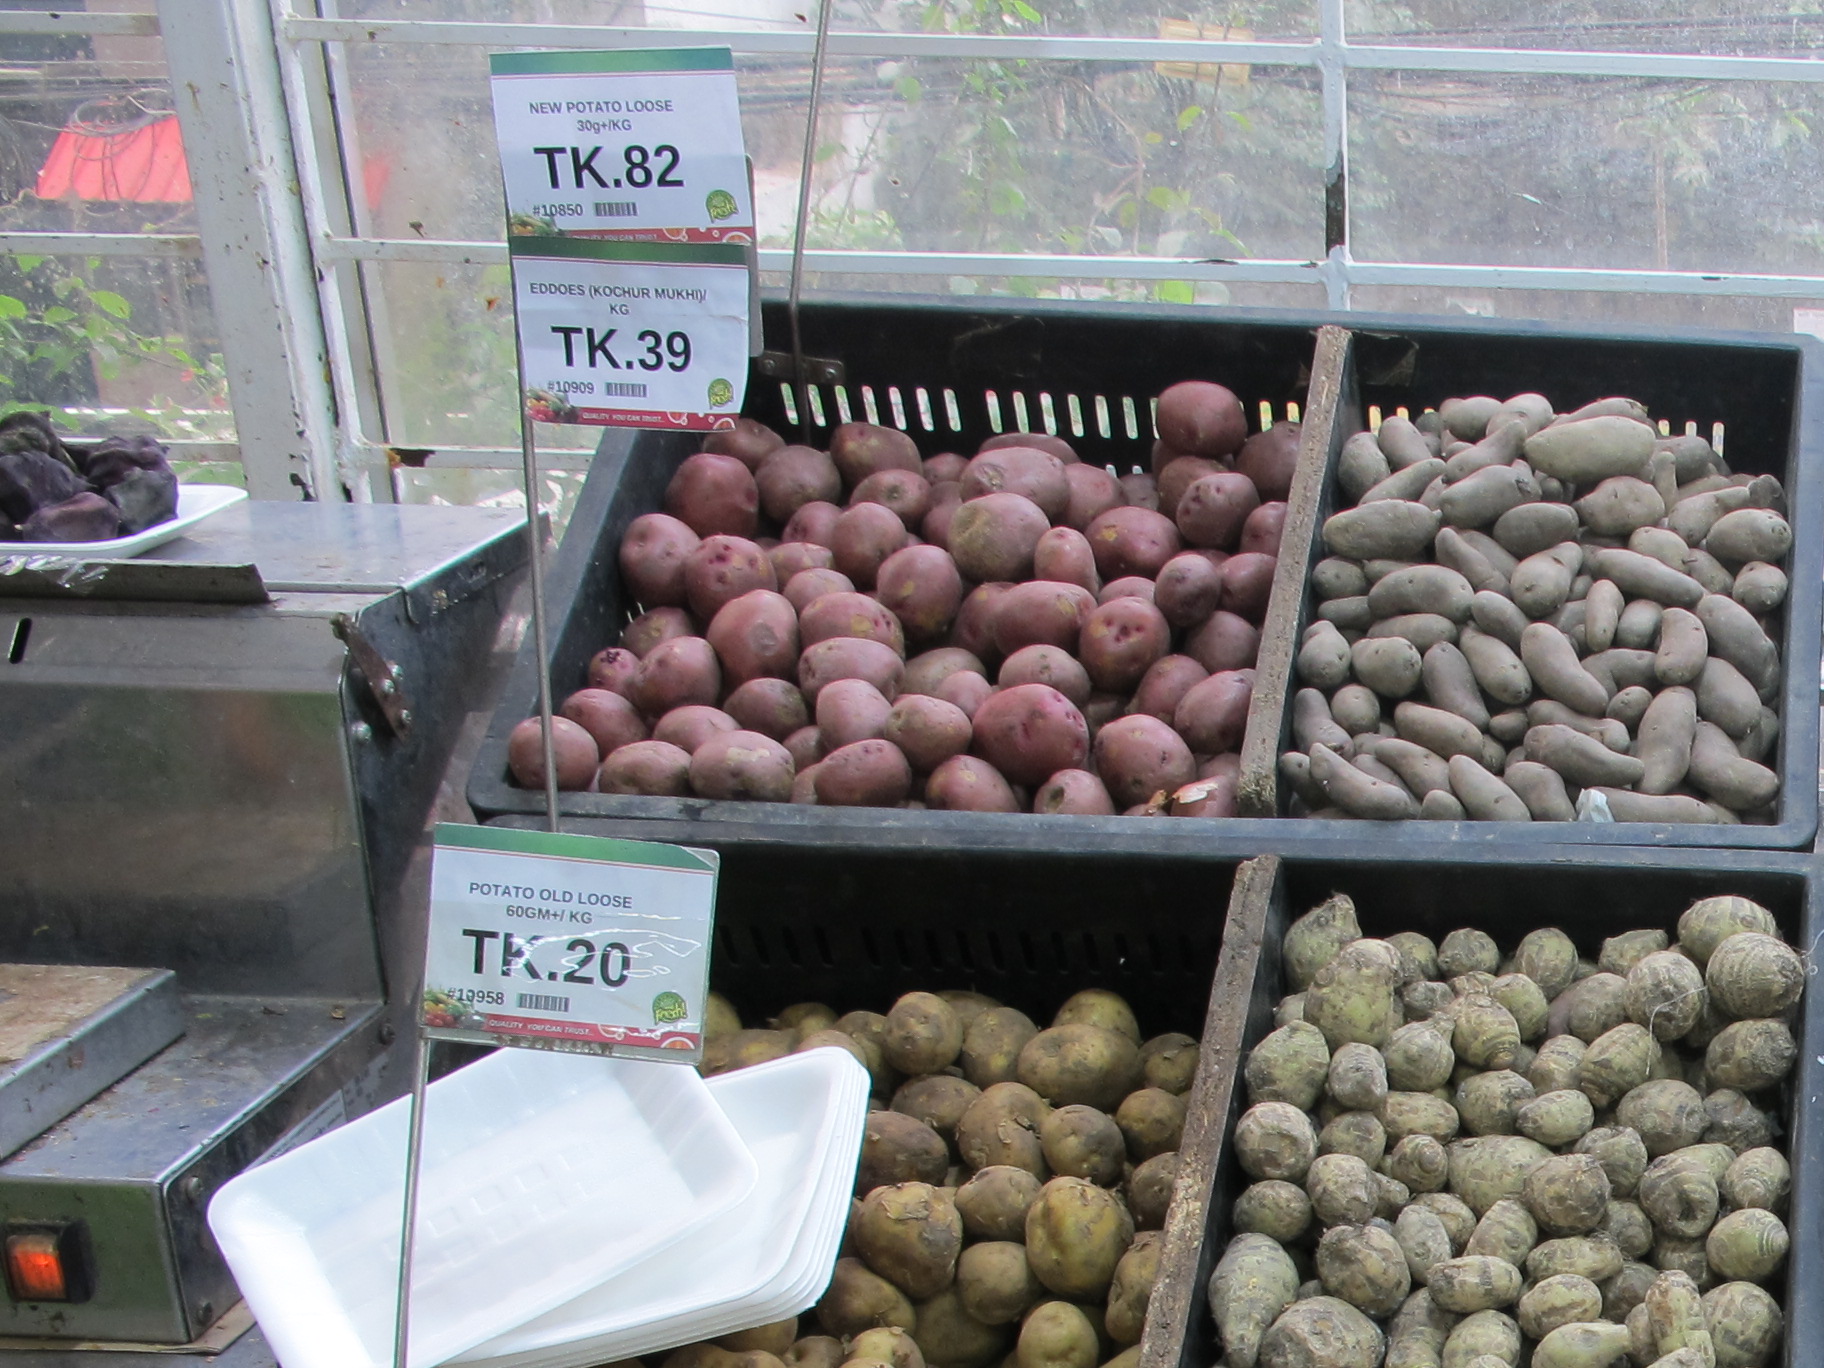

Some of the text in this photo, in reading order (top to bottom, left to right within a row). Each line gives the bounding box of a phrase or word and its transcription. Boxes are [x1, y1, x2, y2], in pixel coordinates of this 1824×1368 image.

[529, 100, 674, 114] NEW POTATO LOOSE
[576, 119, 632, 134] 30g+/KG
[533, 144, 685, 189] TK.82
[532, 203, 583, 217] #10850
[529, 282, 707, 303] EDDOES (KOCHUR MUKHI)/
[609, 303, 630, 315] KG
[550, 325, 692, 372] TK.39
[547, 380, 594, 394] #10909
[469, 882, 633, 909] POTATO OLD LOOSE
[506, 904, 593, 924] 60GM+/ KG
[462, 928, 631, 987] TK.20
[447, 987, 505, 1005] #10958
[489, 1019, 523, 1029] QUALITY
